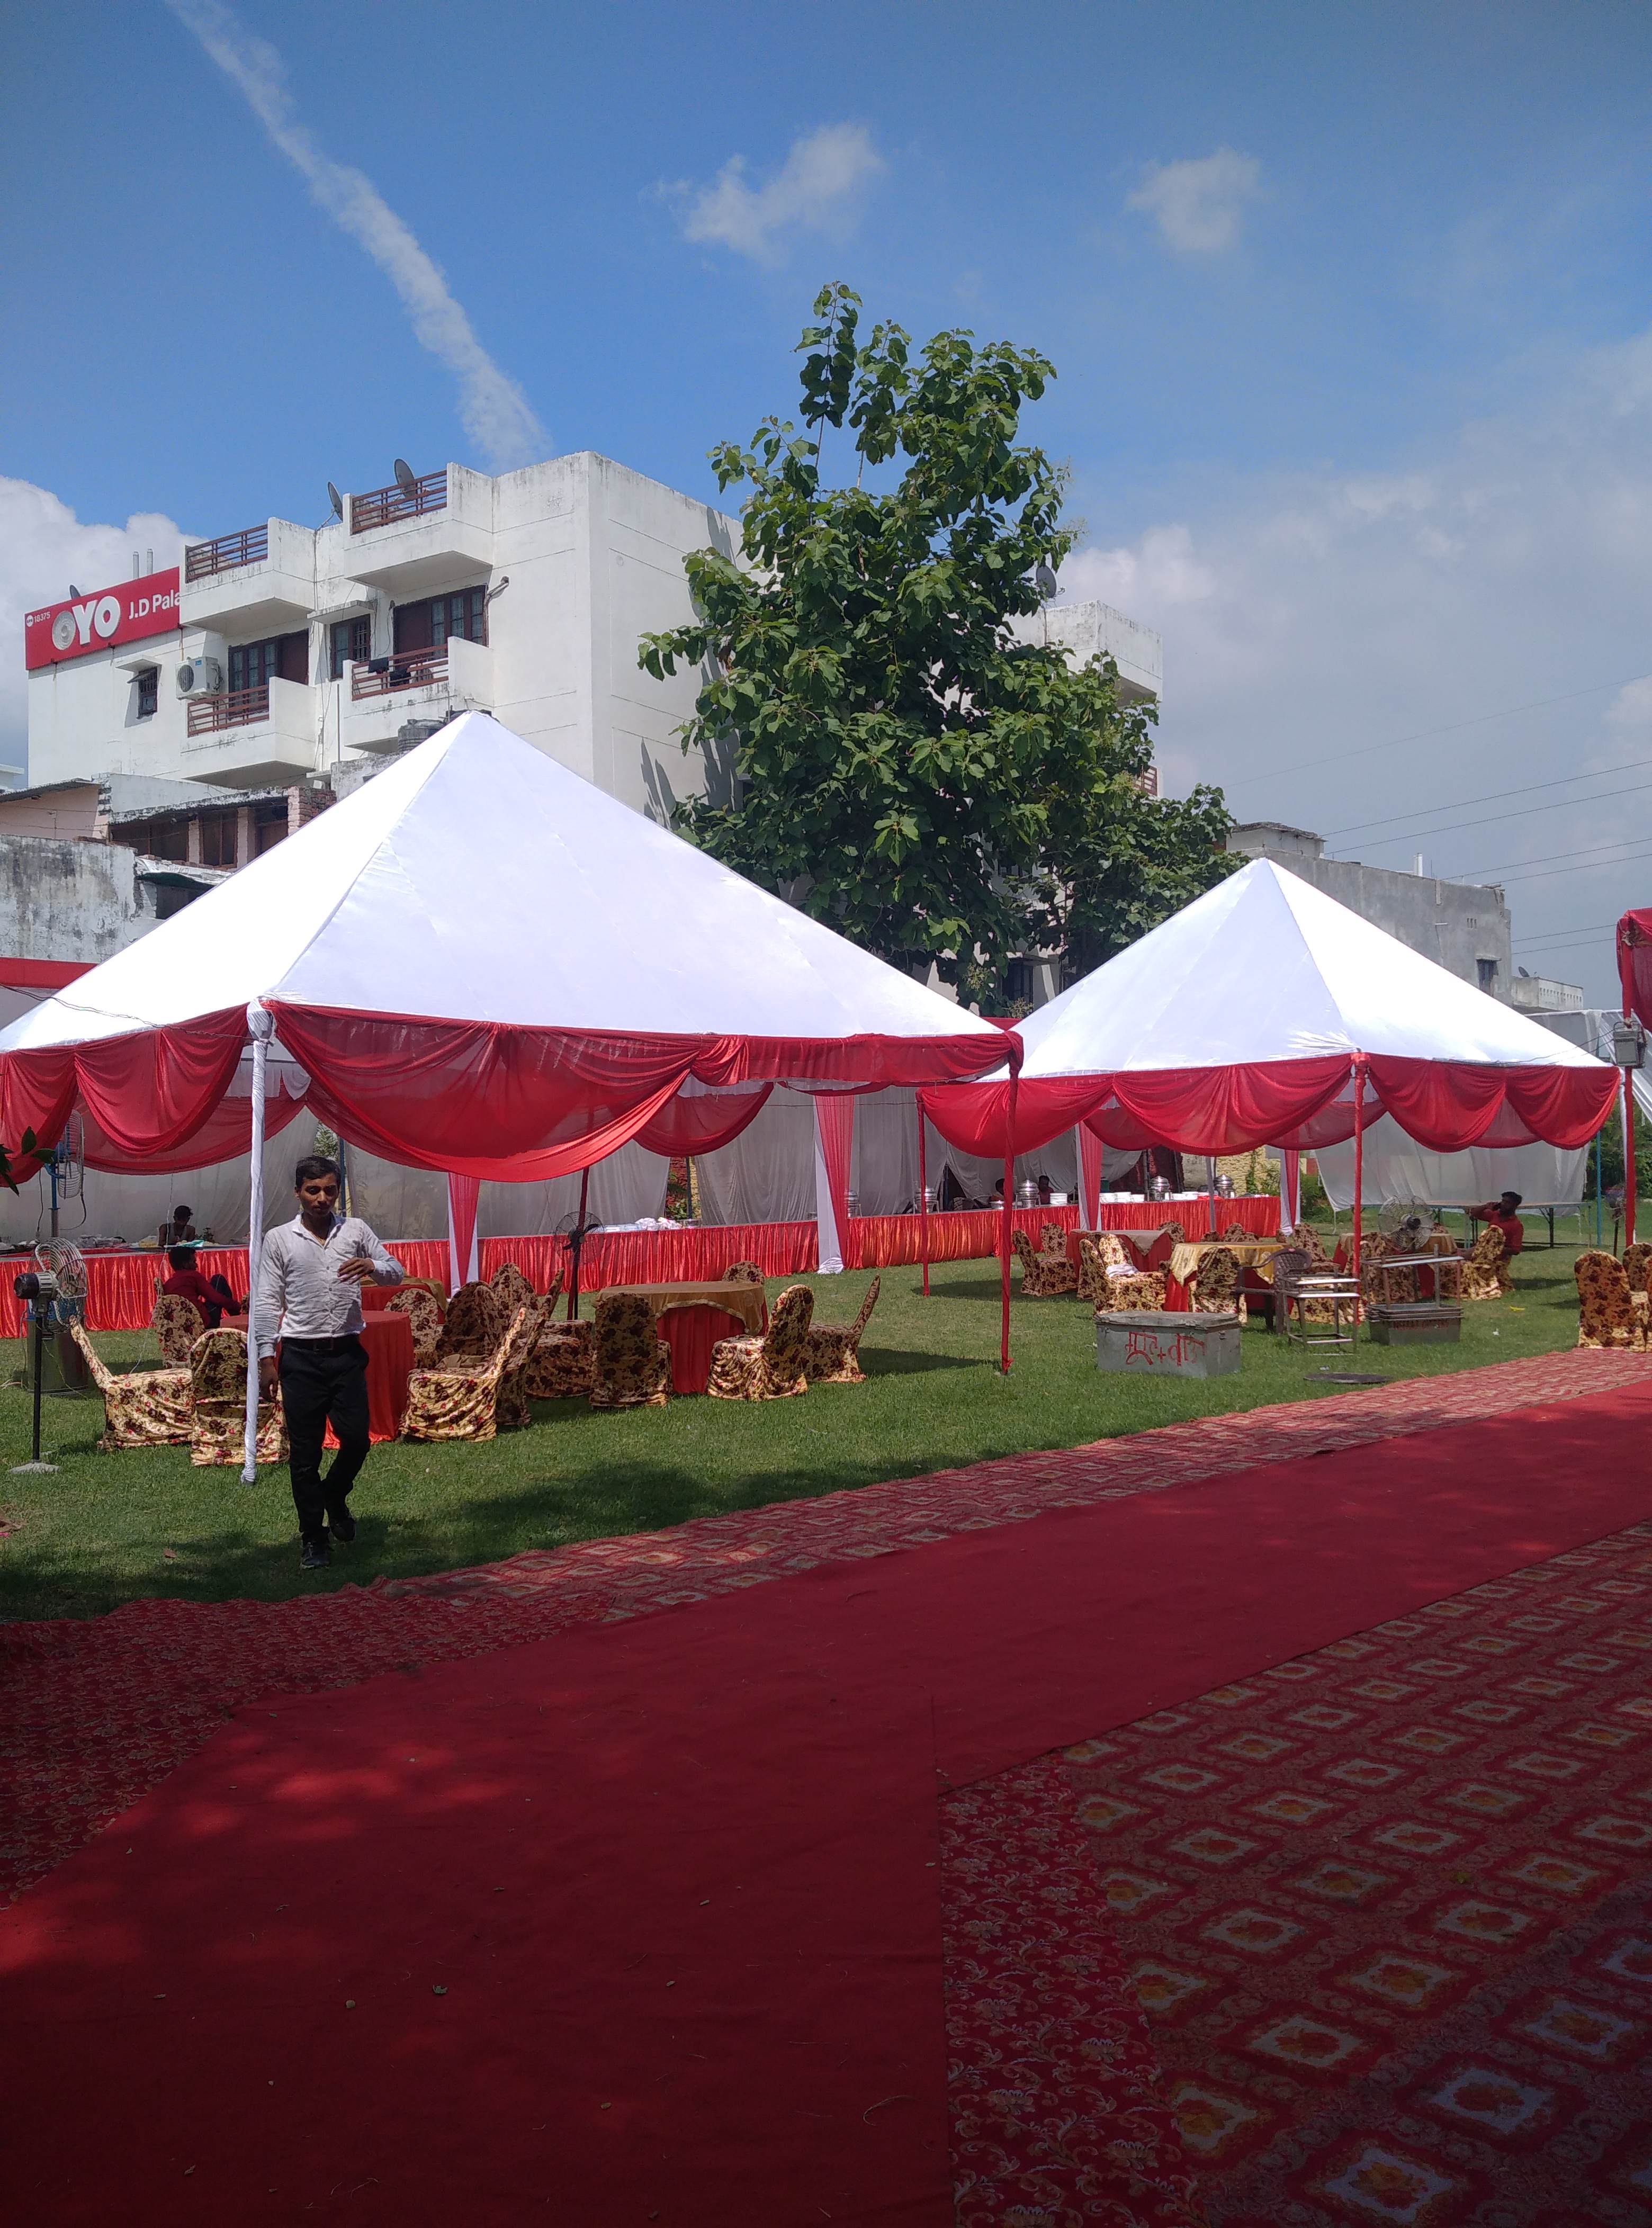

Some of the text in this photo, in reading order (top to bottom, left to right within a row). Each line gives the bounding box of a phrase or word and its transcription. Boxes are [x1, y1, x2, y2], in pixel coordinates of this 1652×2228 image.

[34, 612, 51, 623] 18375
[52, 596, 121, 650] OYO
[129, 598, 149, 619] J.D
